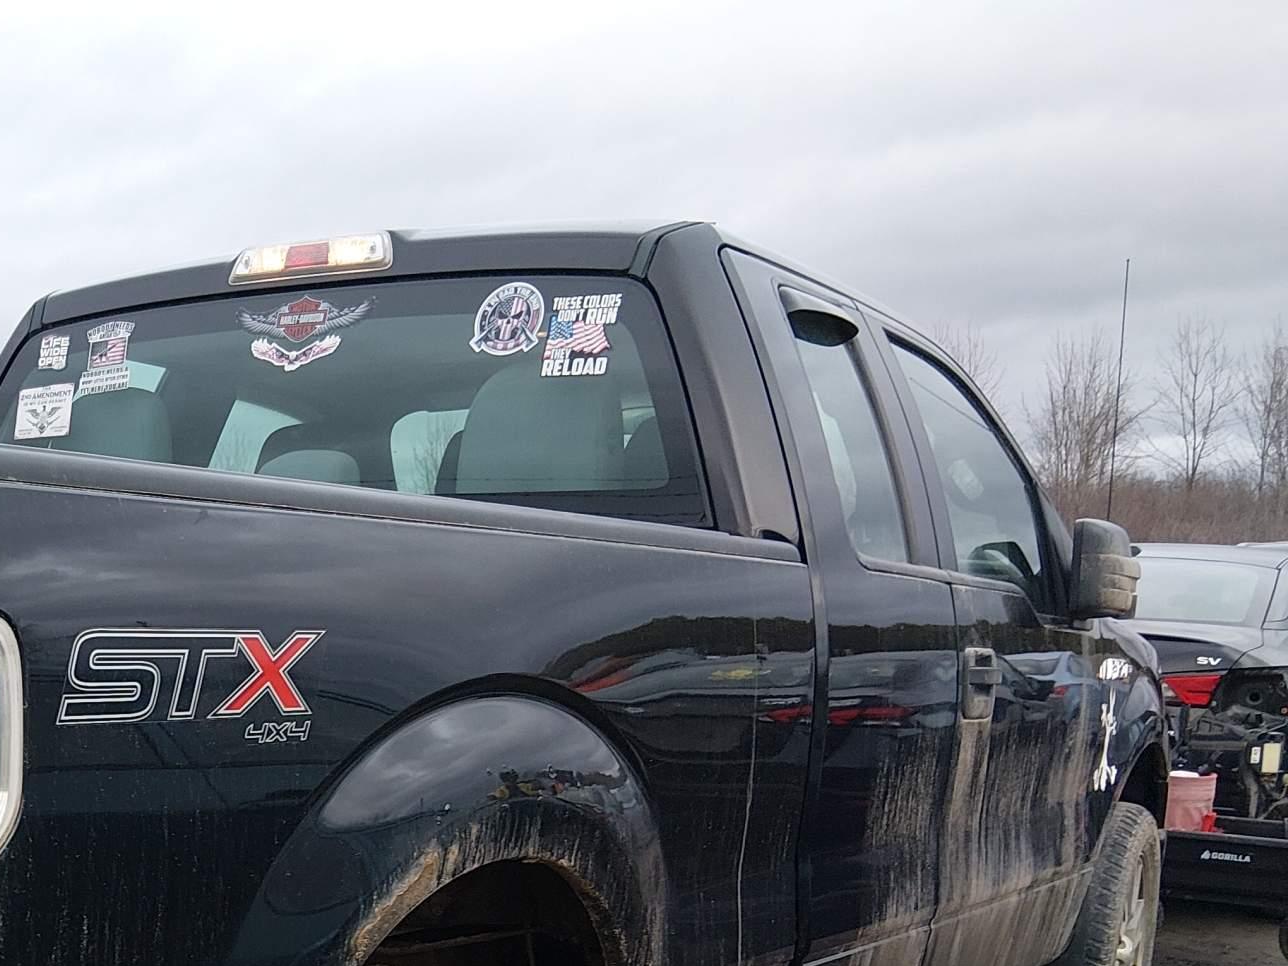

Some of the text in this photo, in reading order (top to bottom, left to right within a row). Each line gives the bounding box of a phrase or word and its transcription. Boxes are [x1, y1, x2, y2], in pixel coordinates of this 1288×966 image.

[552, 296, 583, 310] THESE
[583, 293, 622, 309] COLORS
[557, 307, 618, 325] DON'T RUN
[40, 347, 68, 358] WIDE
[551, 348, 572, 360] THEY
[540, 357, 608, 377] RELOAD
[32, 389, 73, 400] AMENDMENT
[1196, 656, 1222, 666] SV
[56, 628, 327, 725] STX
[1211, 852, 1251, 862] GORILLA
